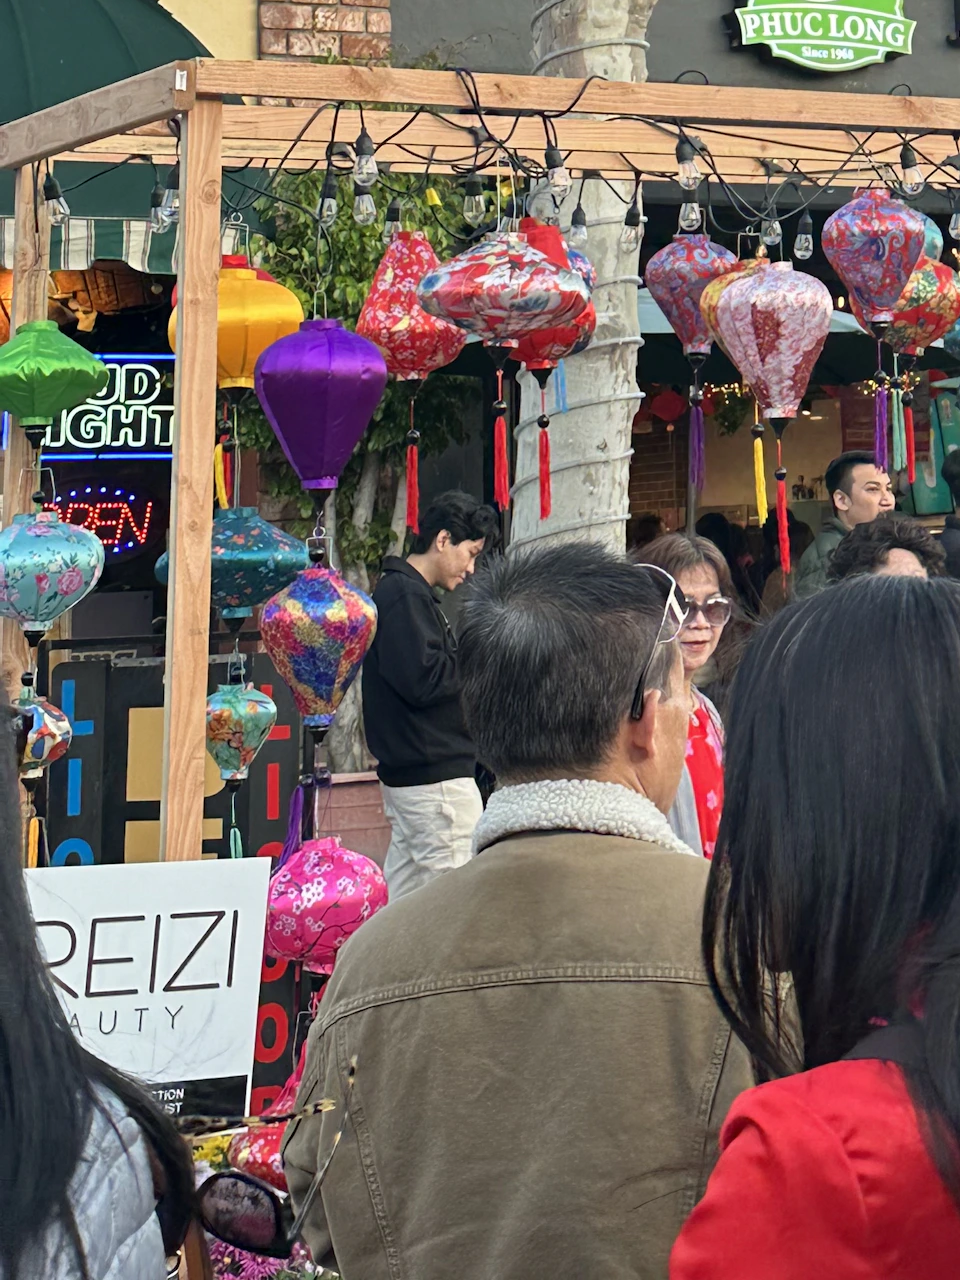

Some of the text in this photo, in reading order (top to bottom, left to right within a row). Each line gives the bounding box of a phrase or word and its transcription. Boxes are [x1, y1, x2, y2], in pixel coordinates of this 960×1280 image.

[743, 12, 905, 47] PHUC LONG
[801, 45, 829, 59] Since
[86, 363, 161, 404] UD
[41, 404, 175, 448] IGHT
[70, 1004, 184, 1037] AUTY
[151, 1087, 185, 1101] TION
